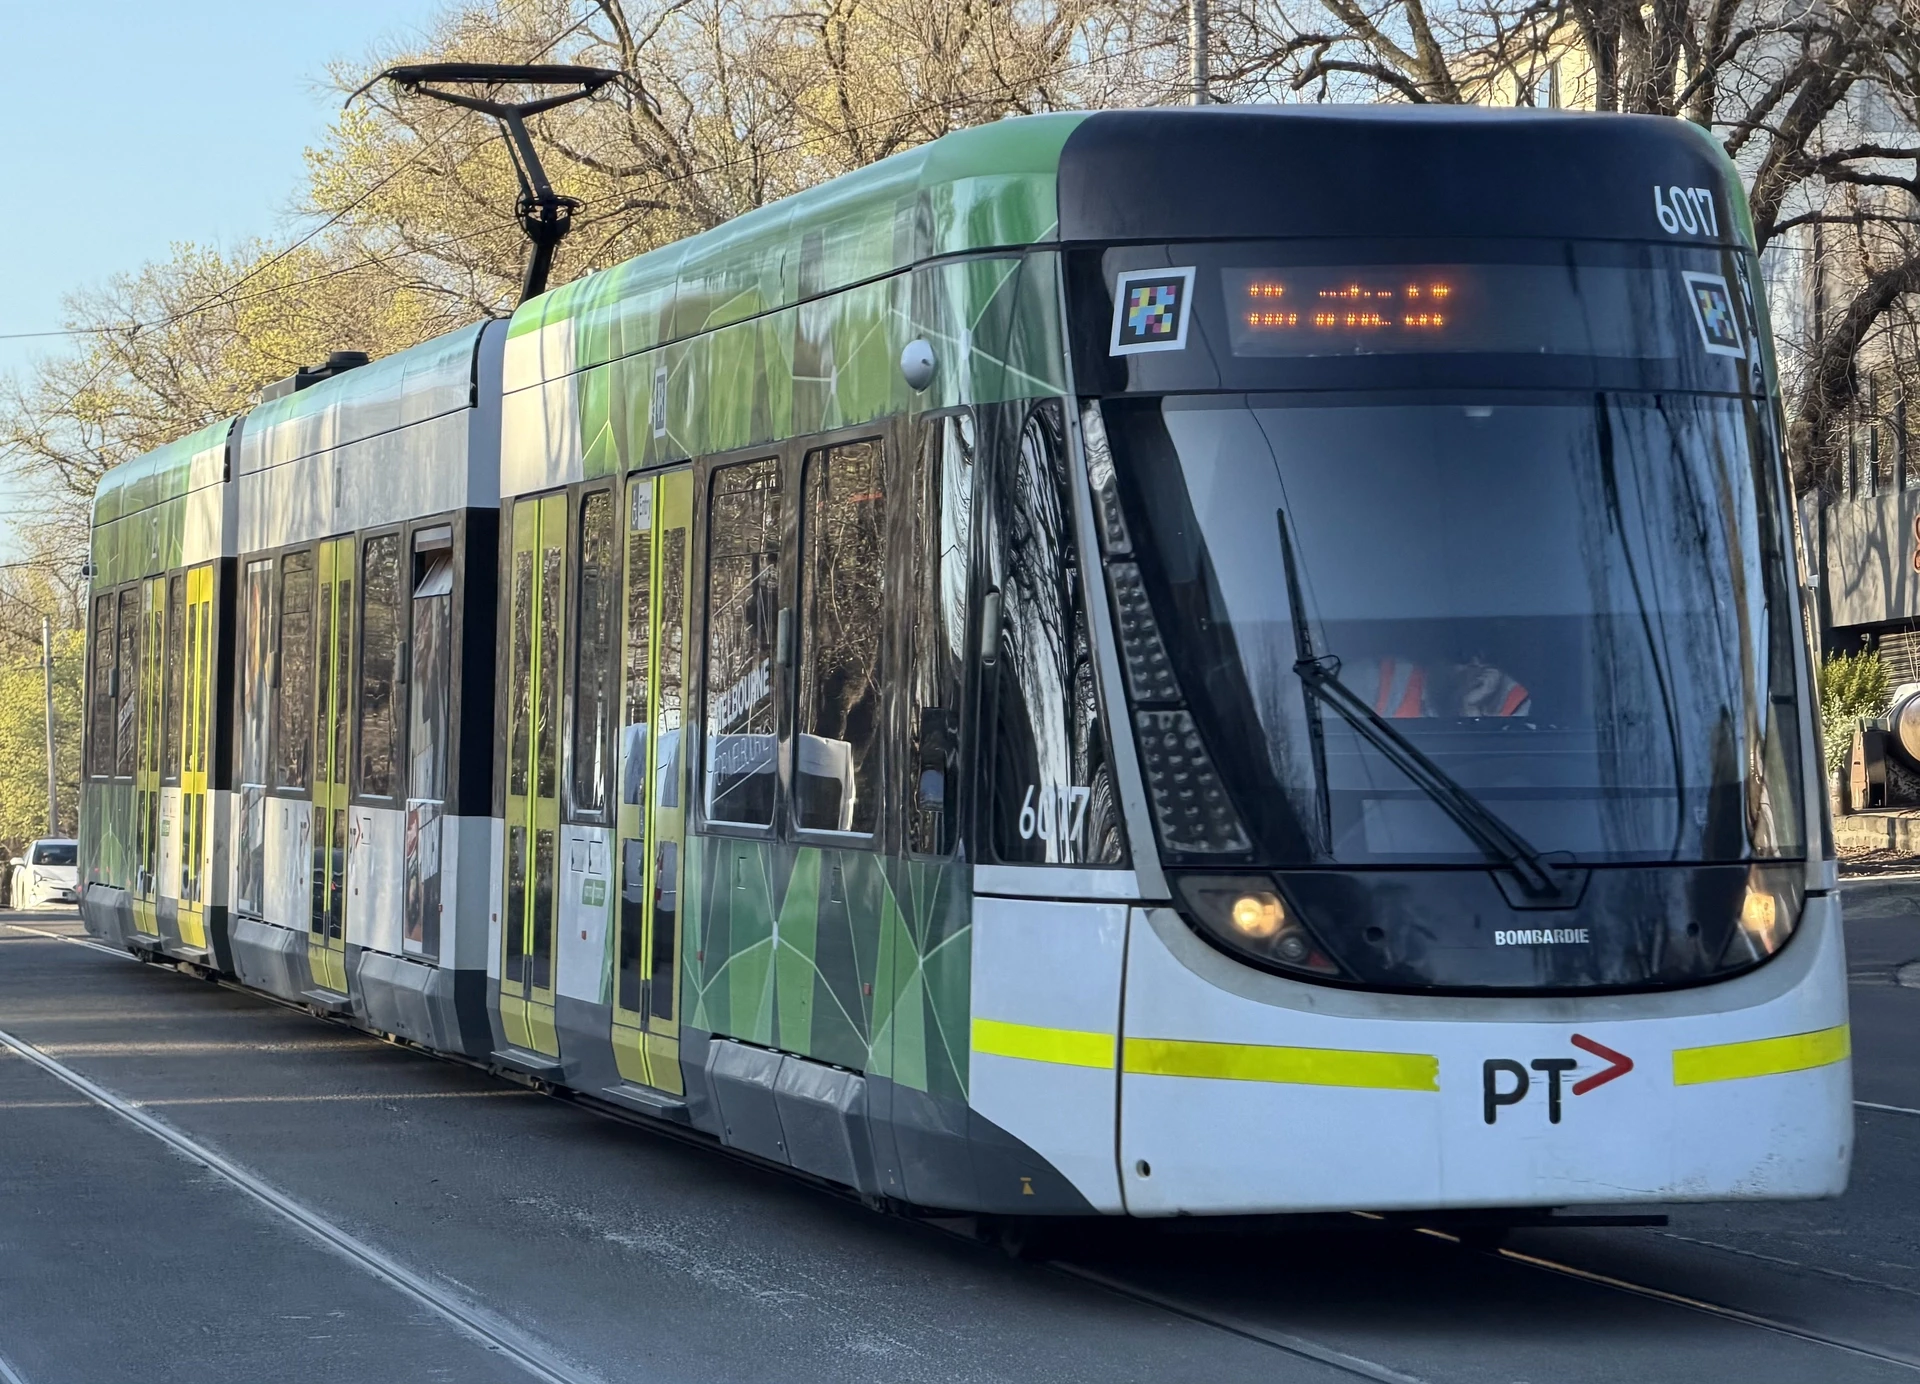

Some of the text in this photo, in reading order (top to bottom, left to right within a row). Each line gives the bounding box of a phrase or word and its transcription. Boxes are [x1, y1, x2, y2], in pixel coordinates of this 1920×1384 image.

[1654, 185, 1719, 237] 6017
[1019, 784, 1091, 841] 6017
[1494, 928, 1590, 946] BOMBARDIE
